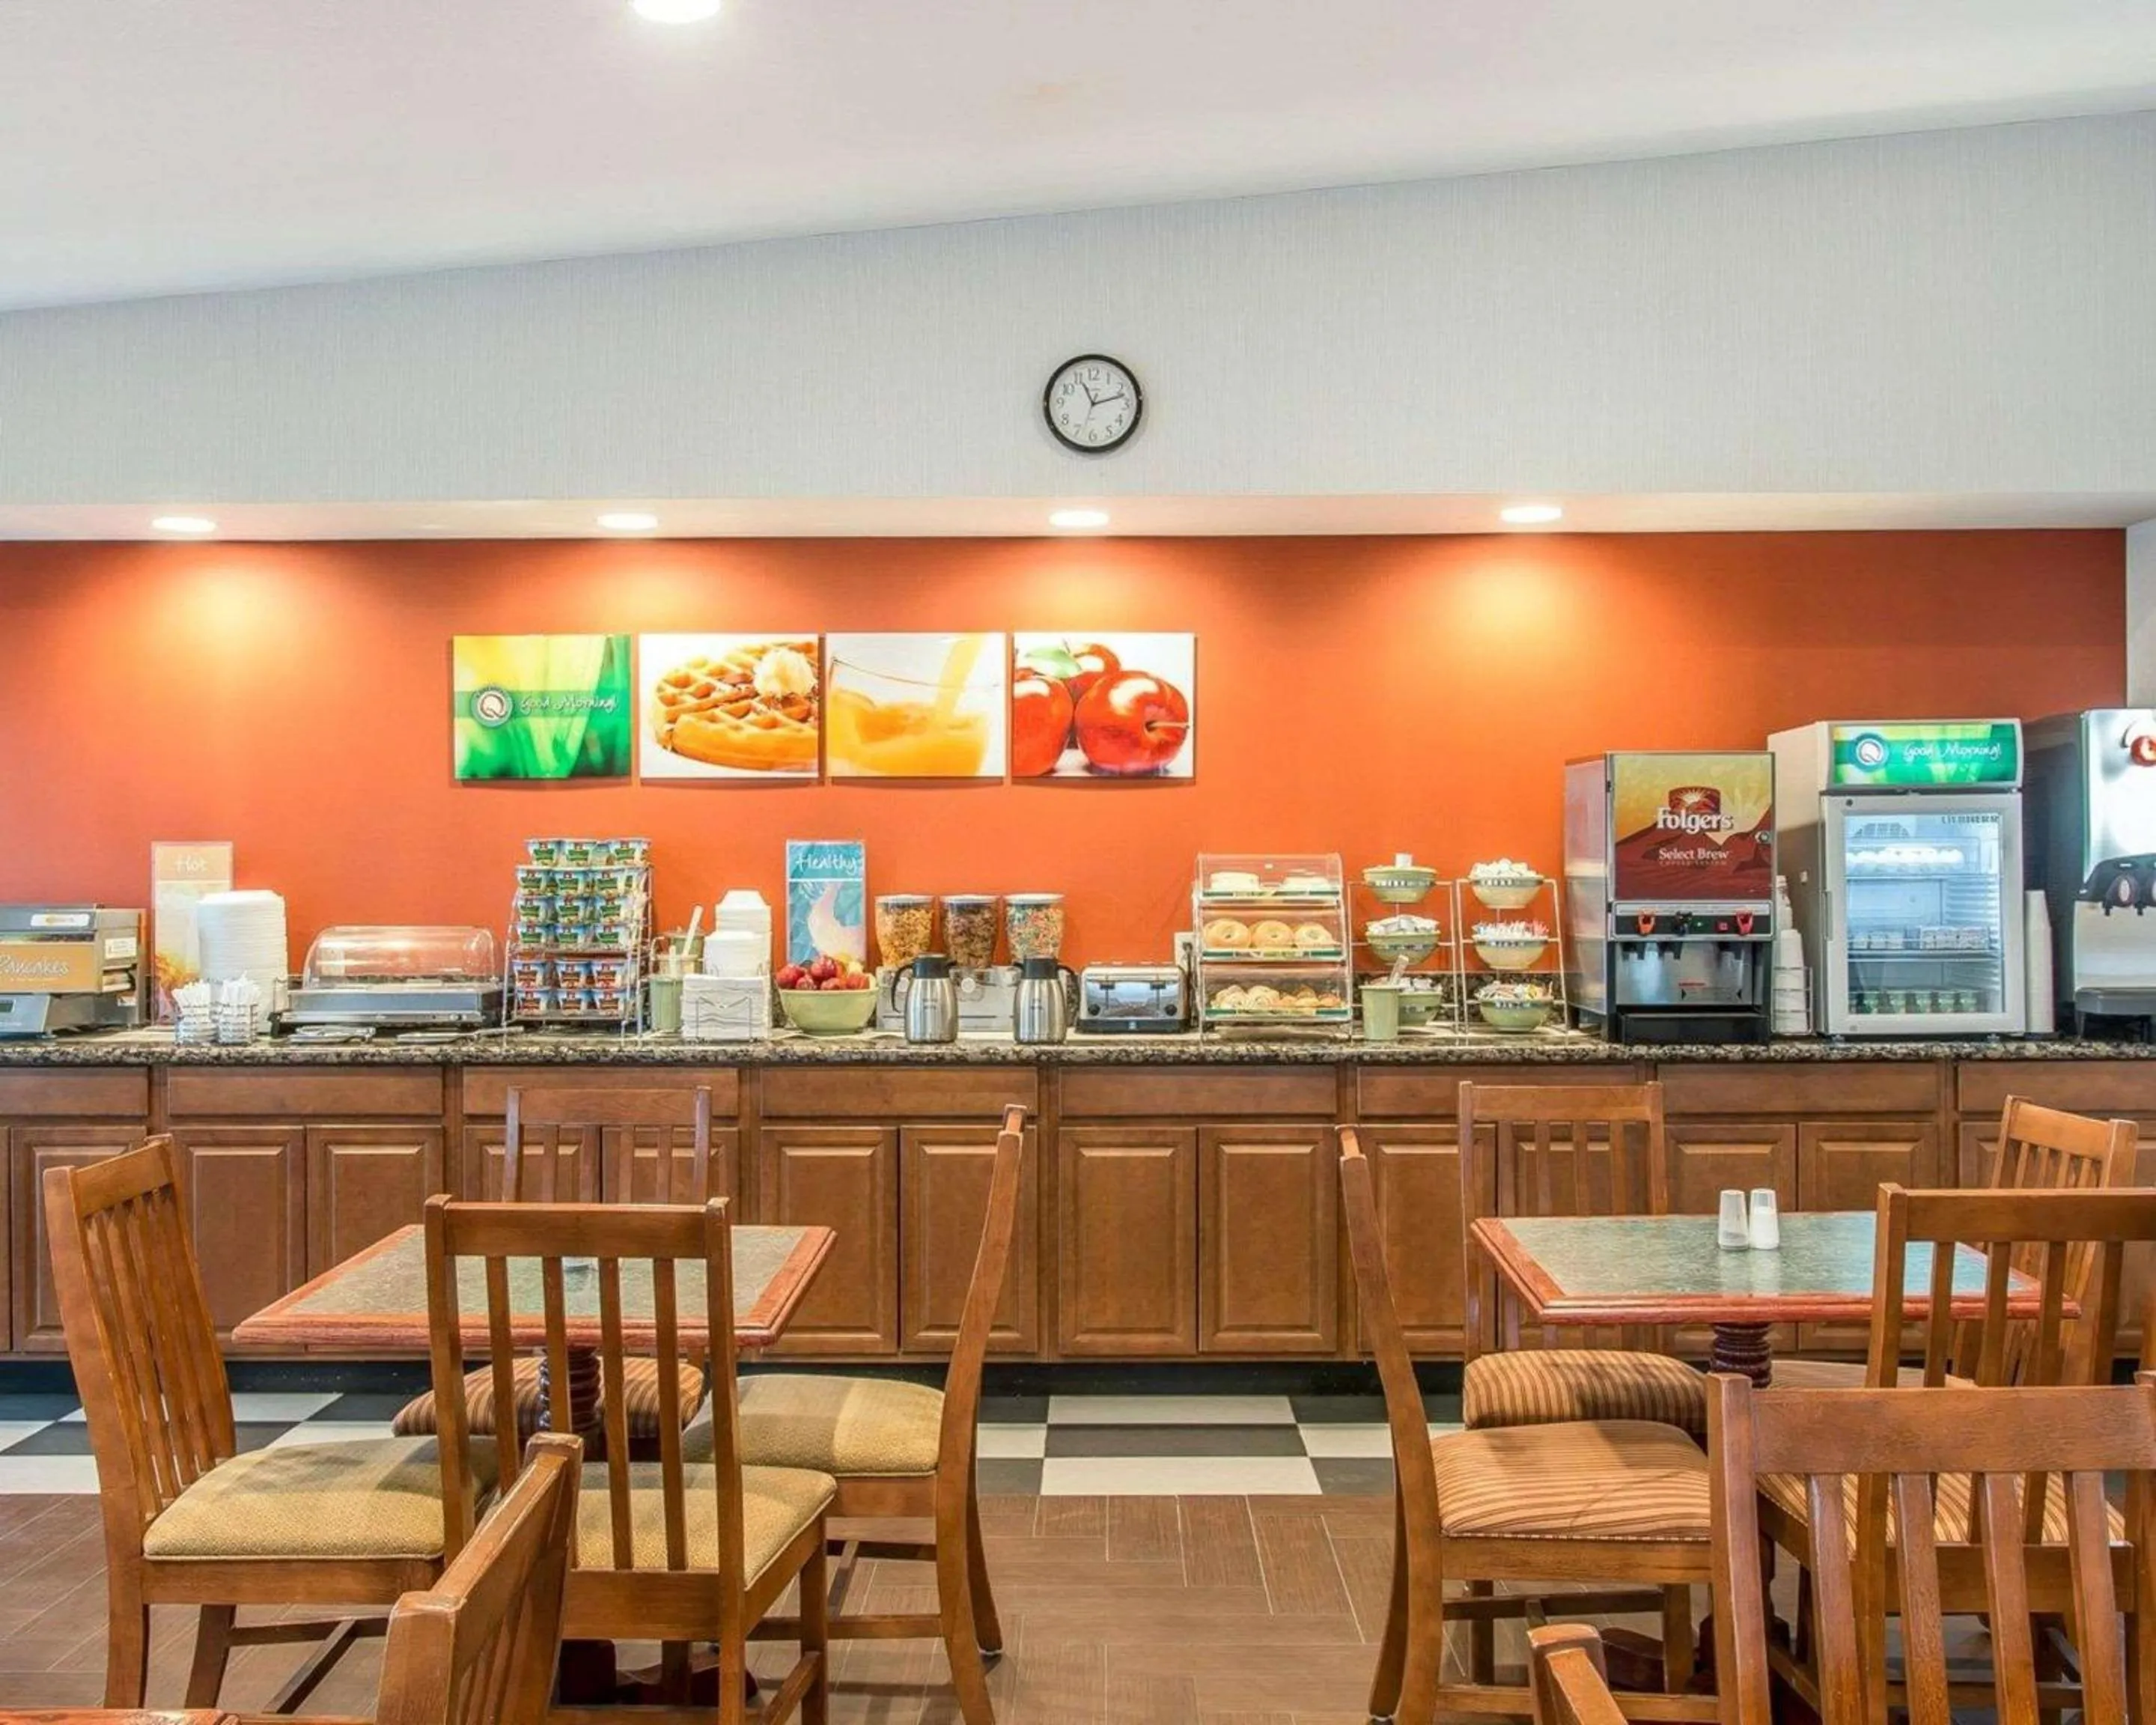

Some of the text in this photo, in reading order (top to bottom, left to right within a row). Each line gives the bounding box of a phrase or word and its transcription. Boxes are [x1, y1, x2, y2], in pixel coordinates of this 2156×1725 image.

[1074, 371, 1083, 385] 11
[1088, 367, 1100, 380] 12
[1063, 383, 1075, 395] 10
[1056, 397, 1065, 408] 9
[1121, 397, 1130, 411] 3
[1062, 413, 1070, 425] 8
[1115, 413, 1123, 426] 4
[1074, 424, 1082, 437] 7
[1088, 429, 1098, 442] 6
[1106, 425, 1113, 438] 5
[520, 695, 550, 715] Good
[1904, 741, 2002, 762] Good Morning!
[1656, 807, 1735, 835] Folgers
[1658, 848, 1730, 860] Select Brew
[174, 854, 209, 874] Hot
[795, 853, 858, 875] Healthy
